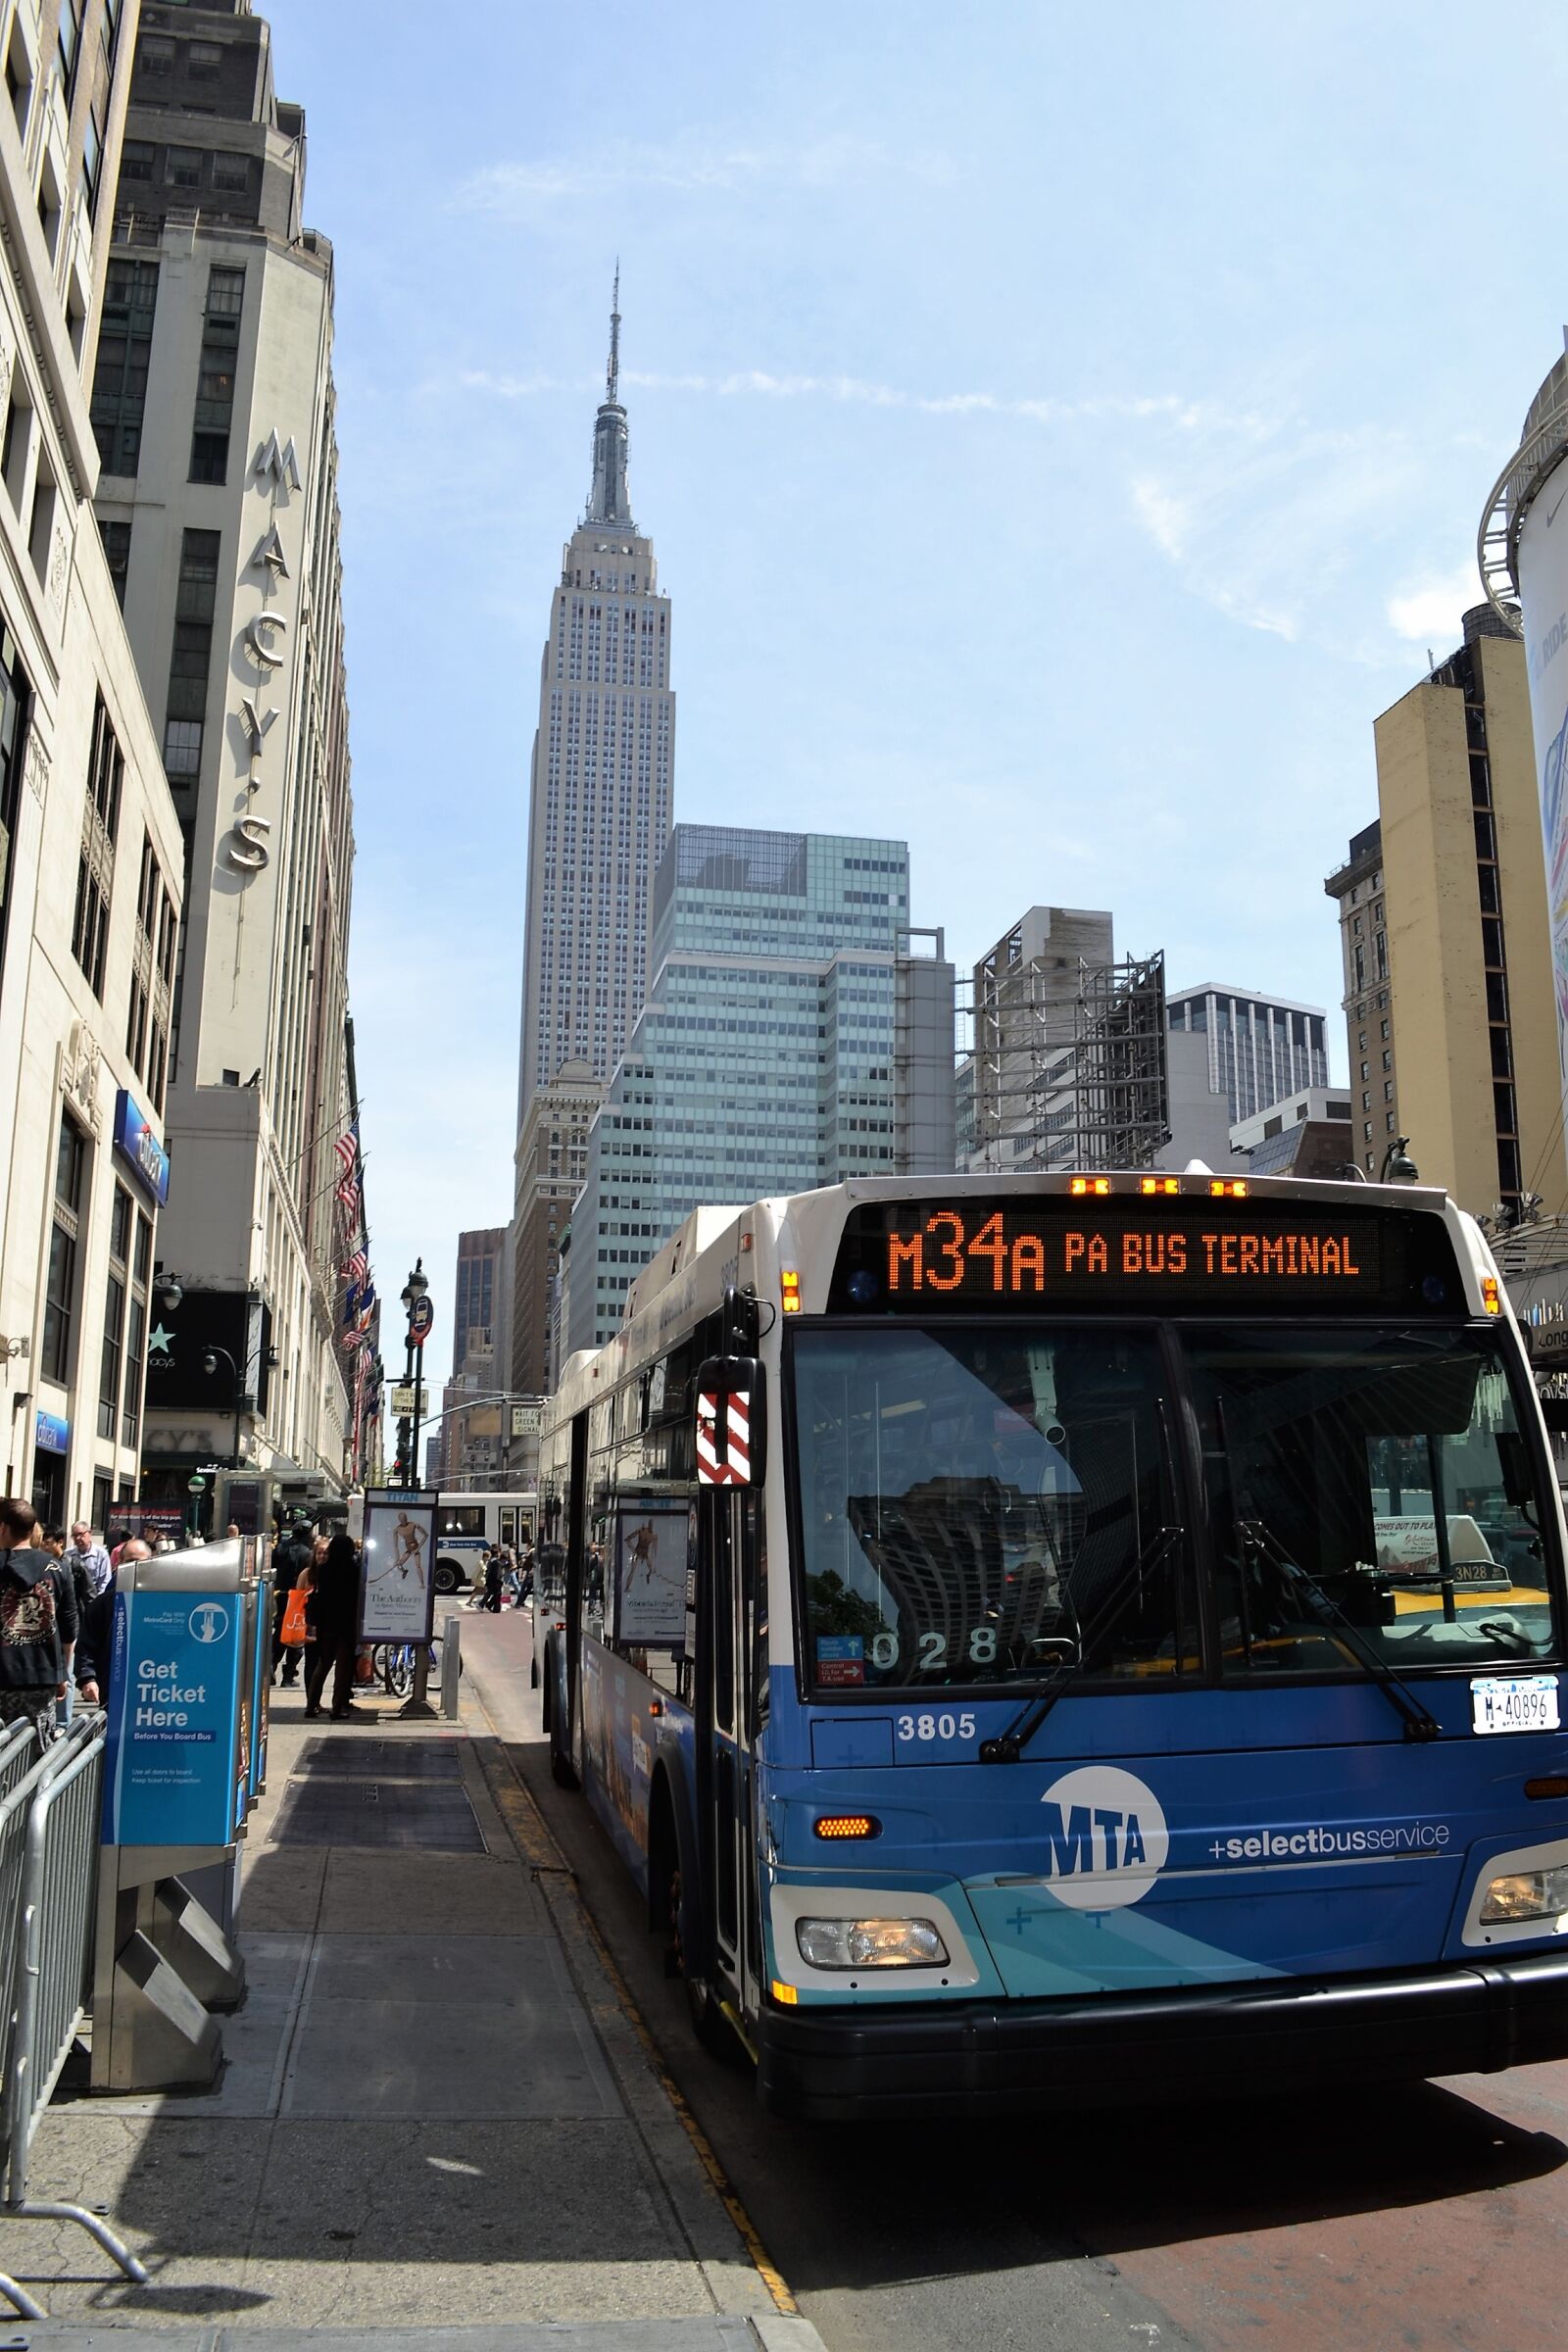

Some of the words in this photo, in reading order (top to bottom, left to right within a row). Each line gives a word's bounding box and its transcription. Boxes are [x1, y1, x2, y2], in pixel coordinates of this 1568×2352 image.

[228, 427, 302, 871] MACY'S
[889, 1212, 1045, 1291] M34A
[1065, 1233, 1107, 1272] PA
[1123, 1234, 1186, 1273] BUS
[1201, 1235, 1359, 1274] TERMINAL
[386, 1493, 419, 1502] TITAN
[1455, 1565, 1487, 1580] 3N28
[387, 1595, 421, 1605] Authority
[138, 1659, 178, 1679] Get
[137, 1684, 206, 1703] Ticket
[136, 1707, 188, 1726] Here
[898, 1713, 976, 1740] 3805
[1039, 1801, 1147, 1878] MTA
